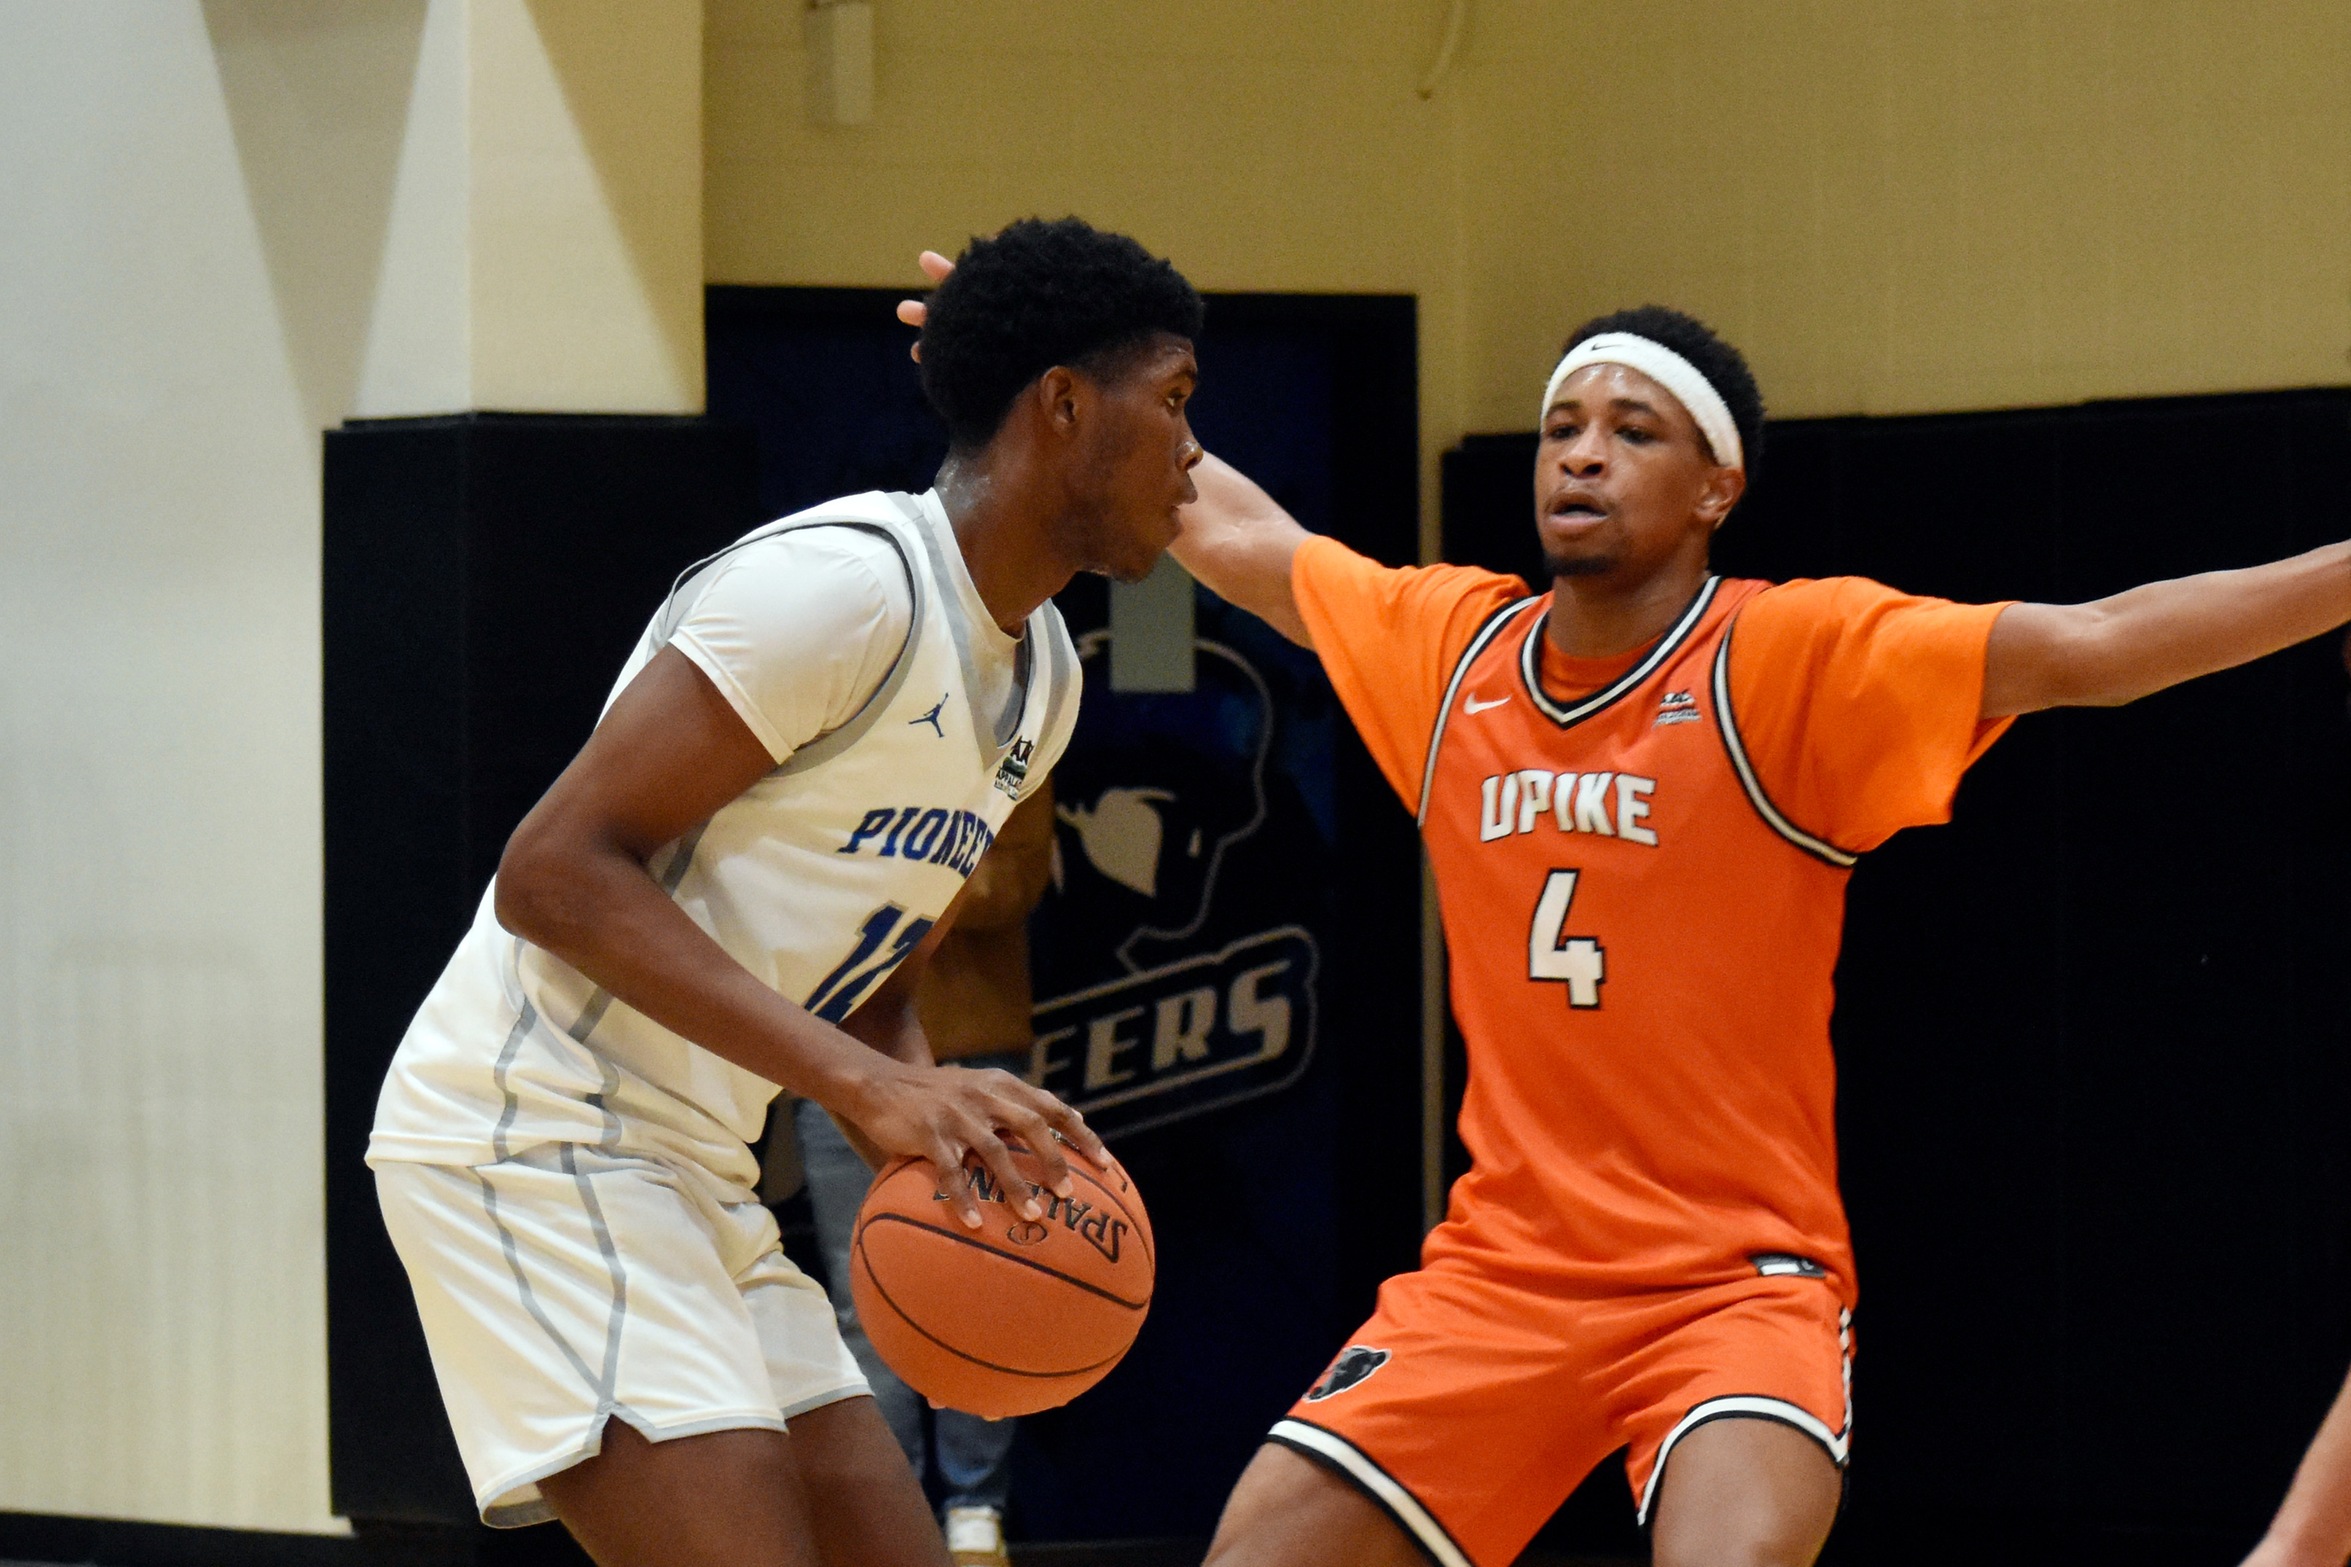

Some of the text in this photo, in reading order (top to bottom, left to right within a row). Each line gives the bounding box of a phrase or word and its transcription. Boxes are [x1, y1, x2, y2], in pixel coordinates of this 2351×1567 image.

[1480, 768, 1659, 847] UPIKE
[804, 901, 938, 1025] 12
[1528, 867, 1607, 1011] 4
